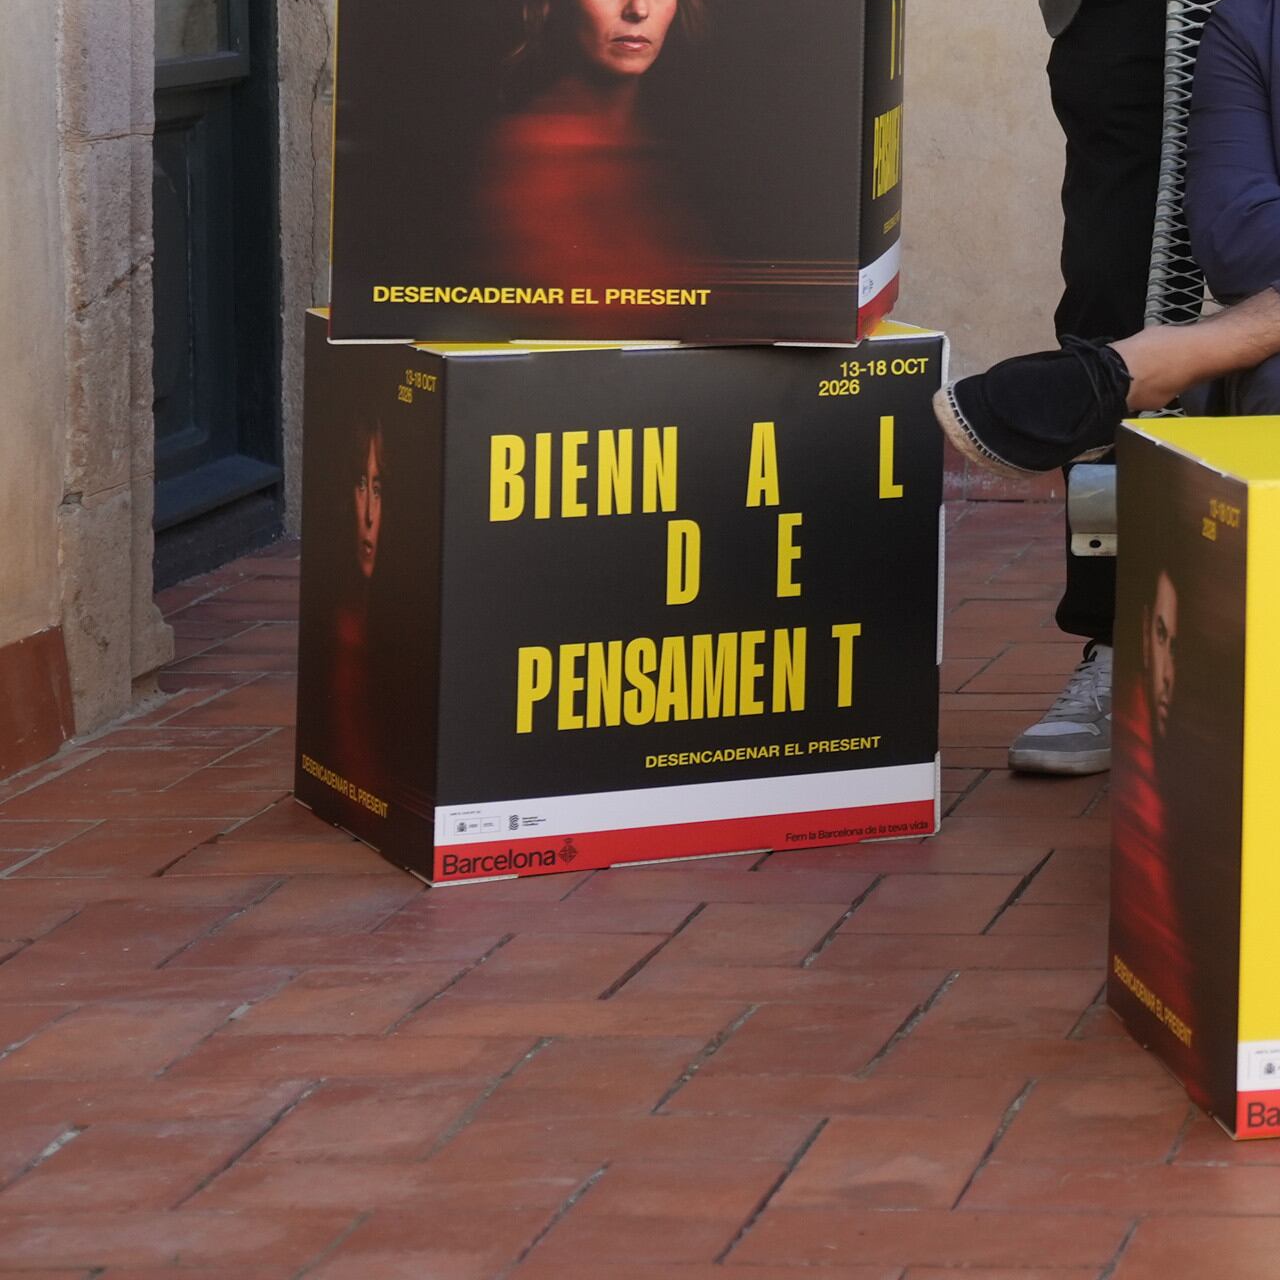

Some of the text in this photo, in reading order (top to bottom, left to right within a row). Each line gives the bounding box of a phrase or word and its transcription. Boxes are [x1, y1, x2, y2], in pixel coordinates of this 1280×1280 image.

[373, 286, 712, 307] DESENCADENAR EL PRESENT
[840, 357, 928, 378] 13-18 OCT
[818, 379, 861, 397] 2026
[645, 735, 881, 769] DESENCADENAR EL PRESENT
[818, 827, 863, 839] Barcelona
[442, 849, 556, 876] Barcelona
